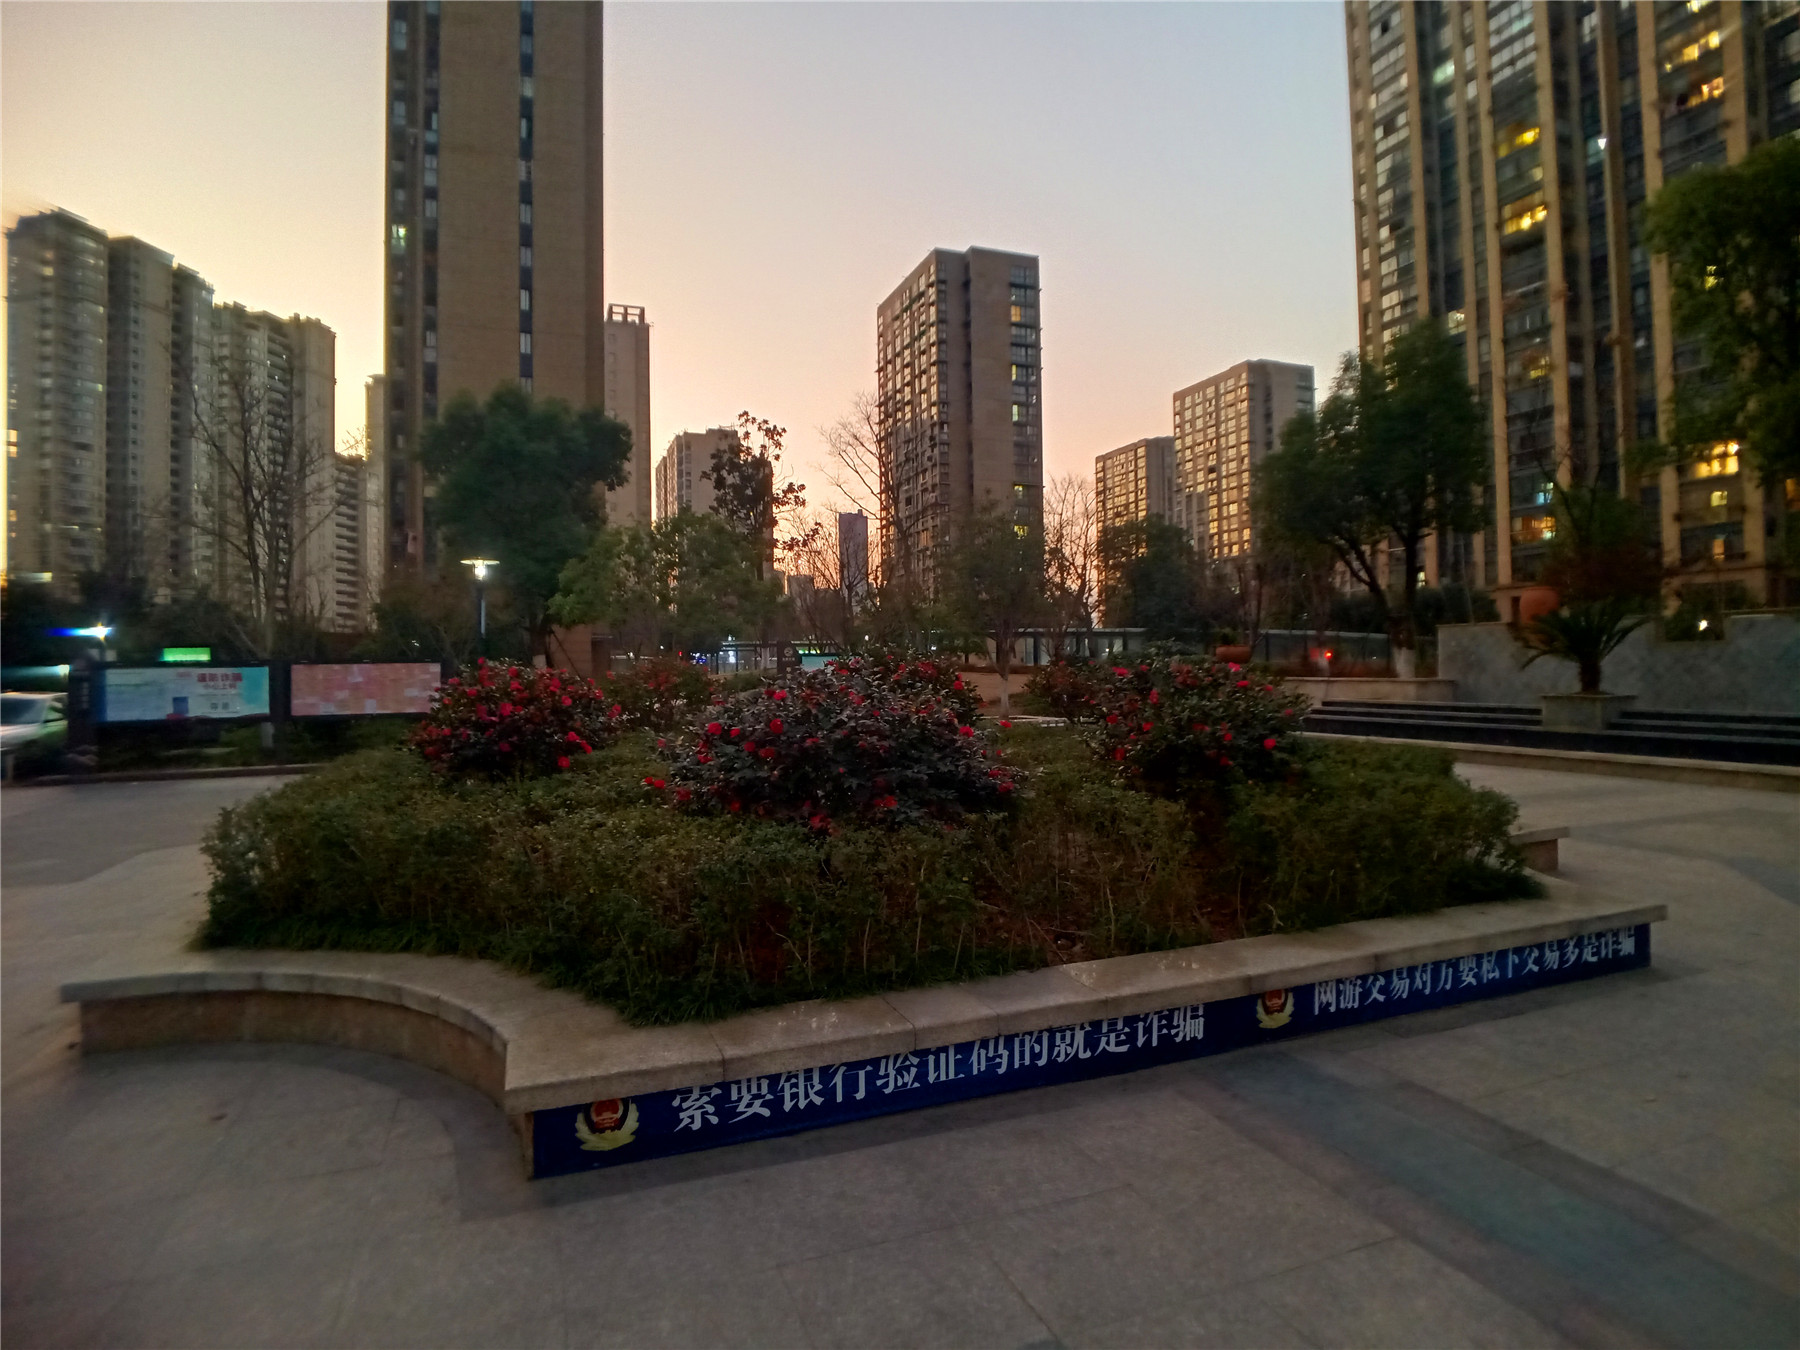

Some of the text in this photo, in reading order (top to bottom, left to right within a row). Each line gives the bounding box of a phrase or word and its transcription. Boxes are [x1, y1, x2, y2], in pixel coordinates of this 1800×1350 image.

[672, 1004, 1205, 1133] 索要银行验证码的就是诈骗
